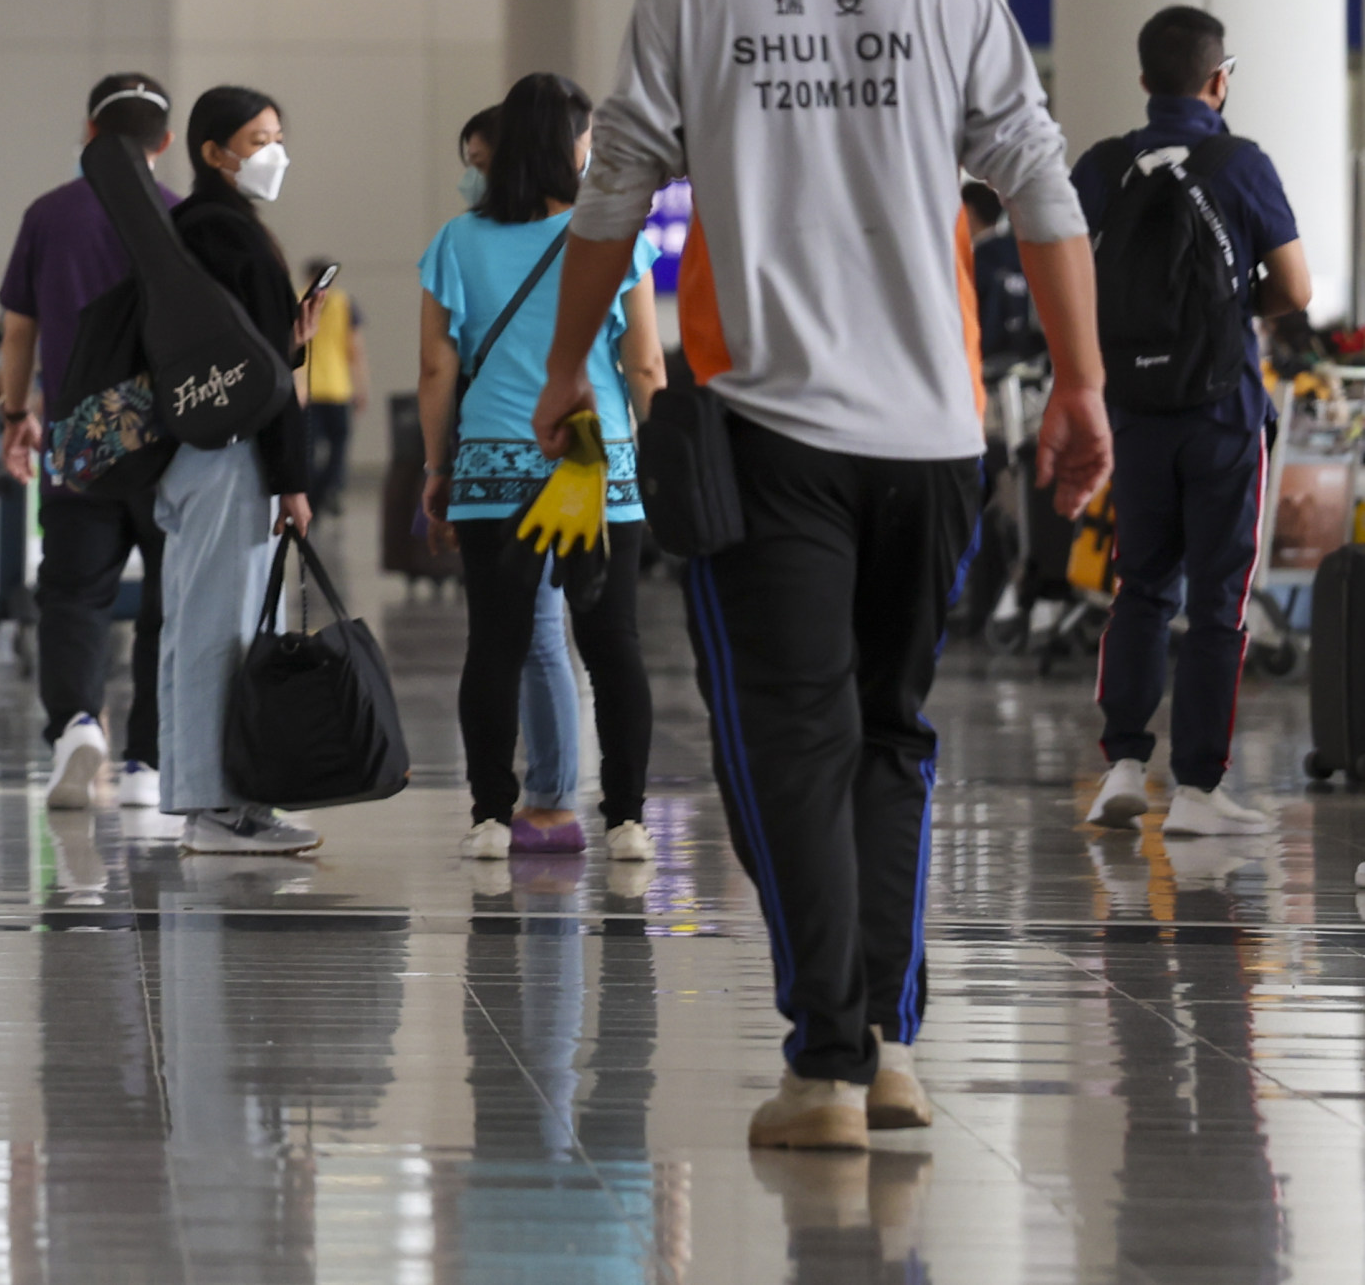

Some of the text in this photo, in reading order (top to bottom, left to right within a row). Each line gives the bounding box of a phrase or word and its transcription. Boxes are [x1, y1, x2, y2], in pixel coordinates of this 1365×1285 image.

[732, 31, 913, 65] SHUI ON
[753, 77, 898, 110] T20M102
